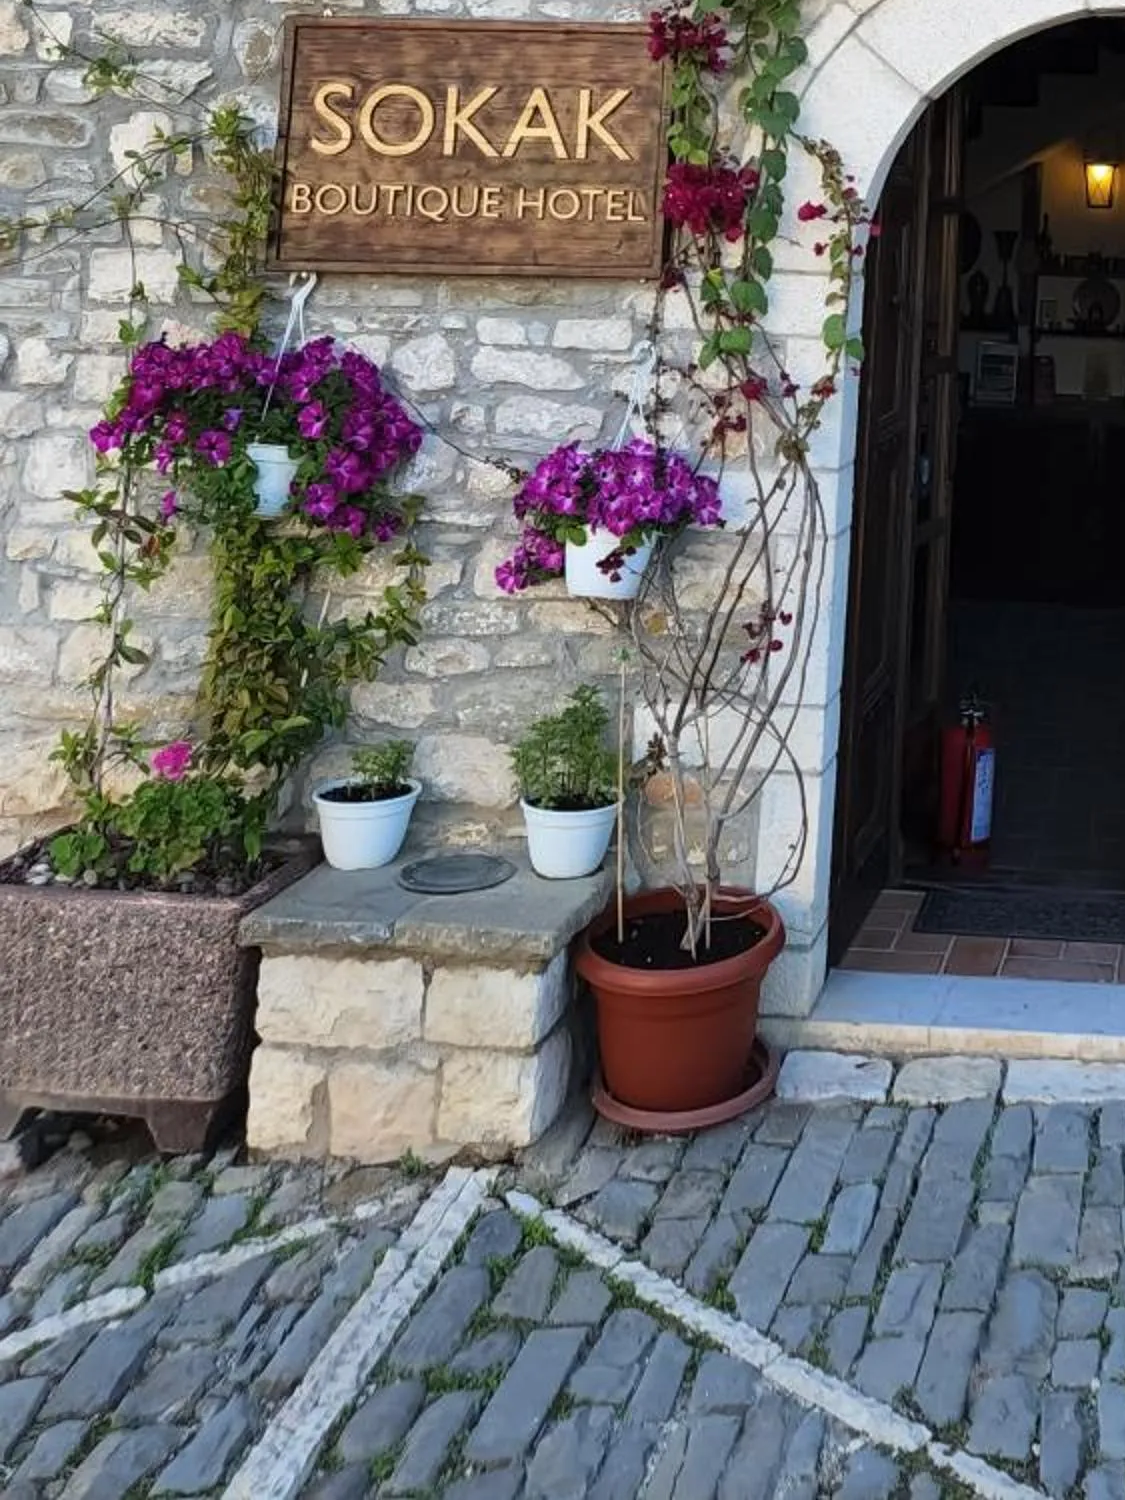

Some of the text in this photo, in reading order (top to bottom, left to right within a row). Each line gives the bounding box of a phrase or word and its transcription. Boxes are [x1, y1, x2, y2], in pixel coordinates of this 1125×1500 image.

[311, 83, 635, 161] SOKAK
[291, 184, 645, 222] BOUTIQUE HOTEL
